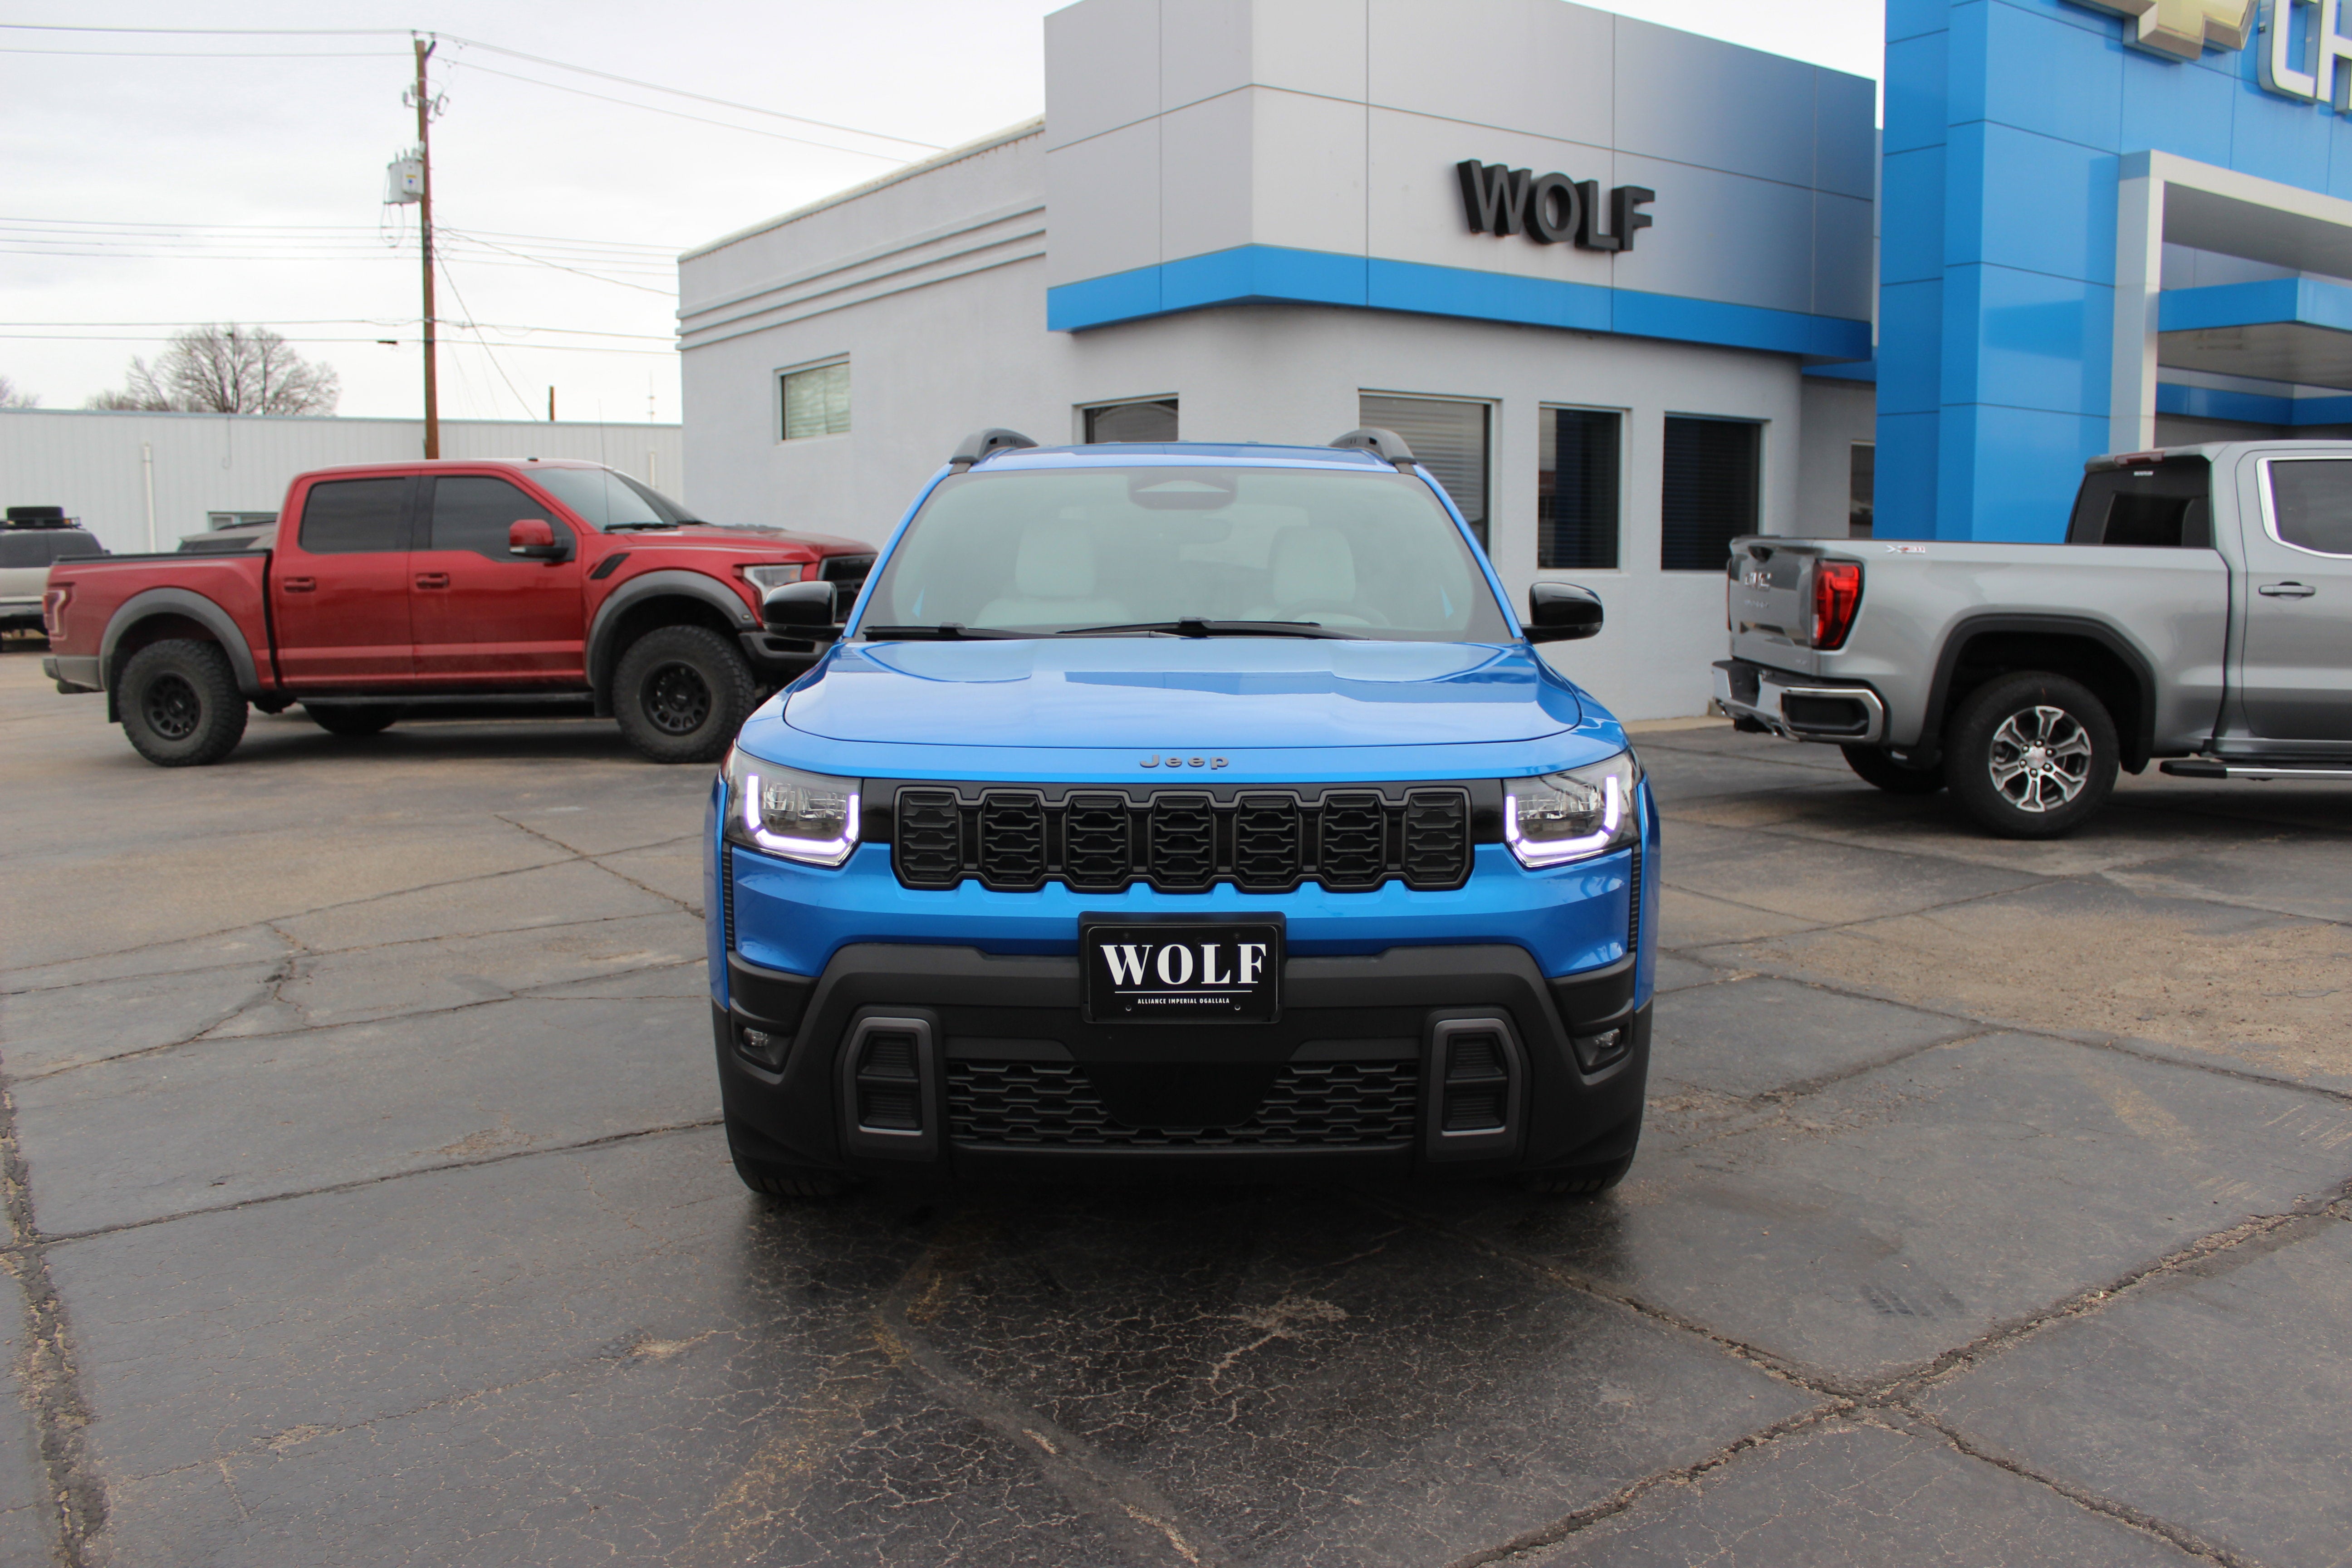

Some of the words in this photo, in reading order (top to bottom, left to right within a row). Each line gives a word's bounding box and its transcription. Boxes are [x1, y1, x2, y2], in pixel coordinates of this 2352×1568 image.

[1457, 158, 1655, 254] WOLF
[1139, 754, 1229, 770] Jeep
[1099, 944, 1266, 985] WOLF
